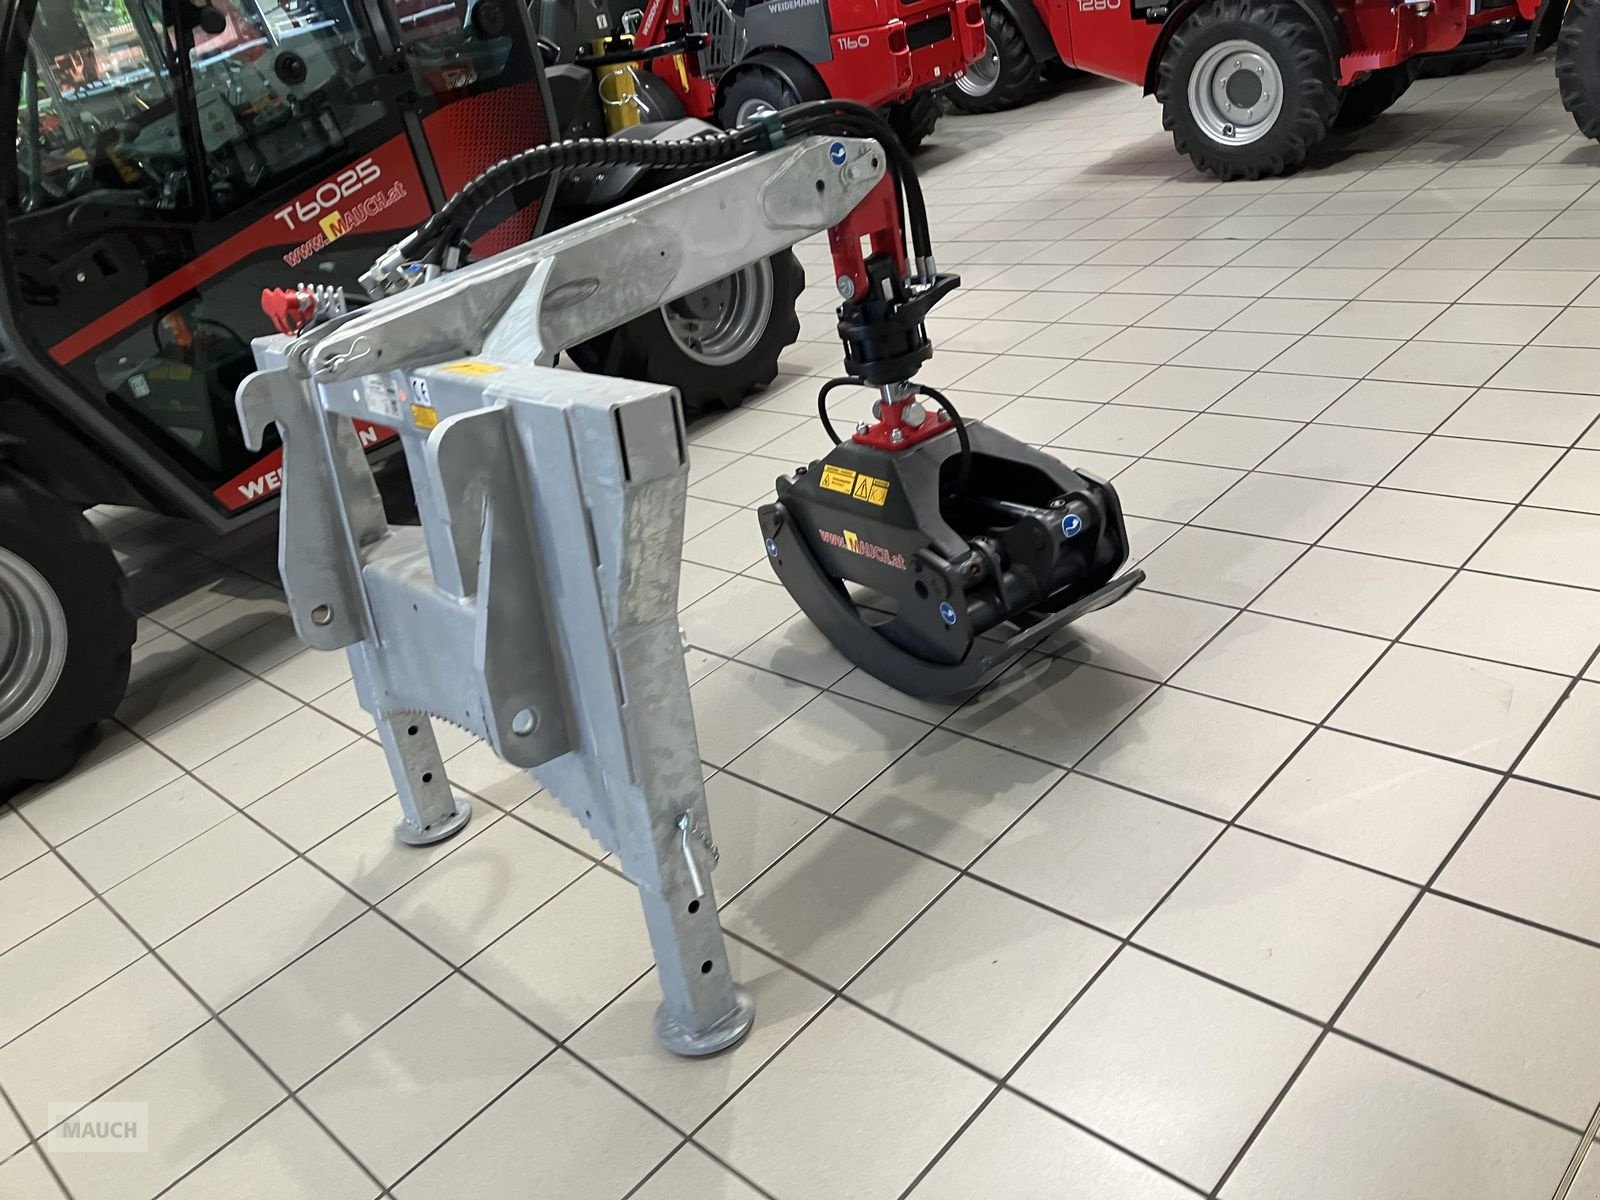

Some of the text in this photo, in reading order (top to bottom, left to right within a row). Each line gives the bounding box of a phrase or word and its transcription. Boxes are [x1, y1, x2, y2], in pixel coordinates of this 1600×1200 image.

[1076, 0, 1121, 11] 1280
[837, 34, 870, 50] 1160
[274, 157, 381, 231] T6025
[283, 180, 407, 267] www.MAUCH.at
